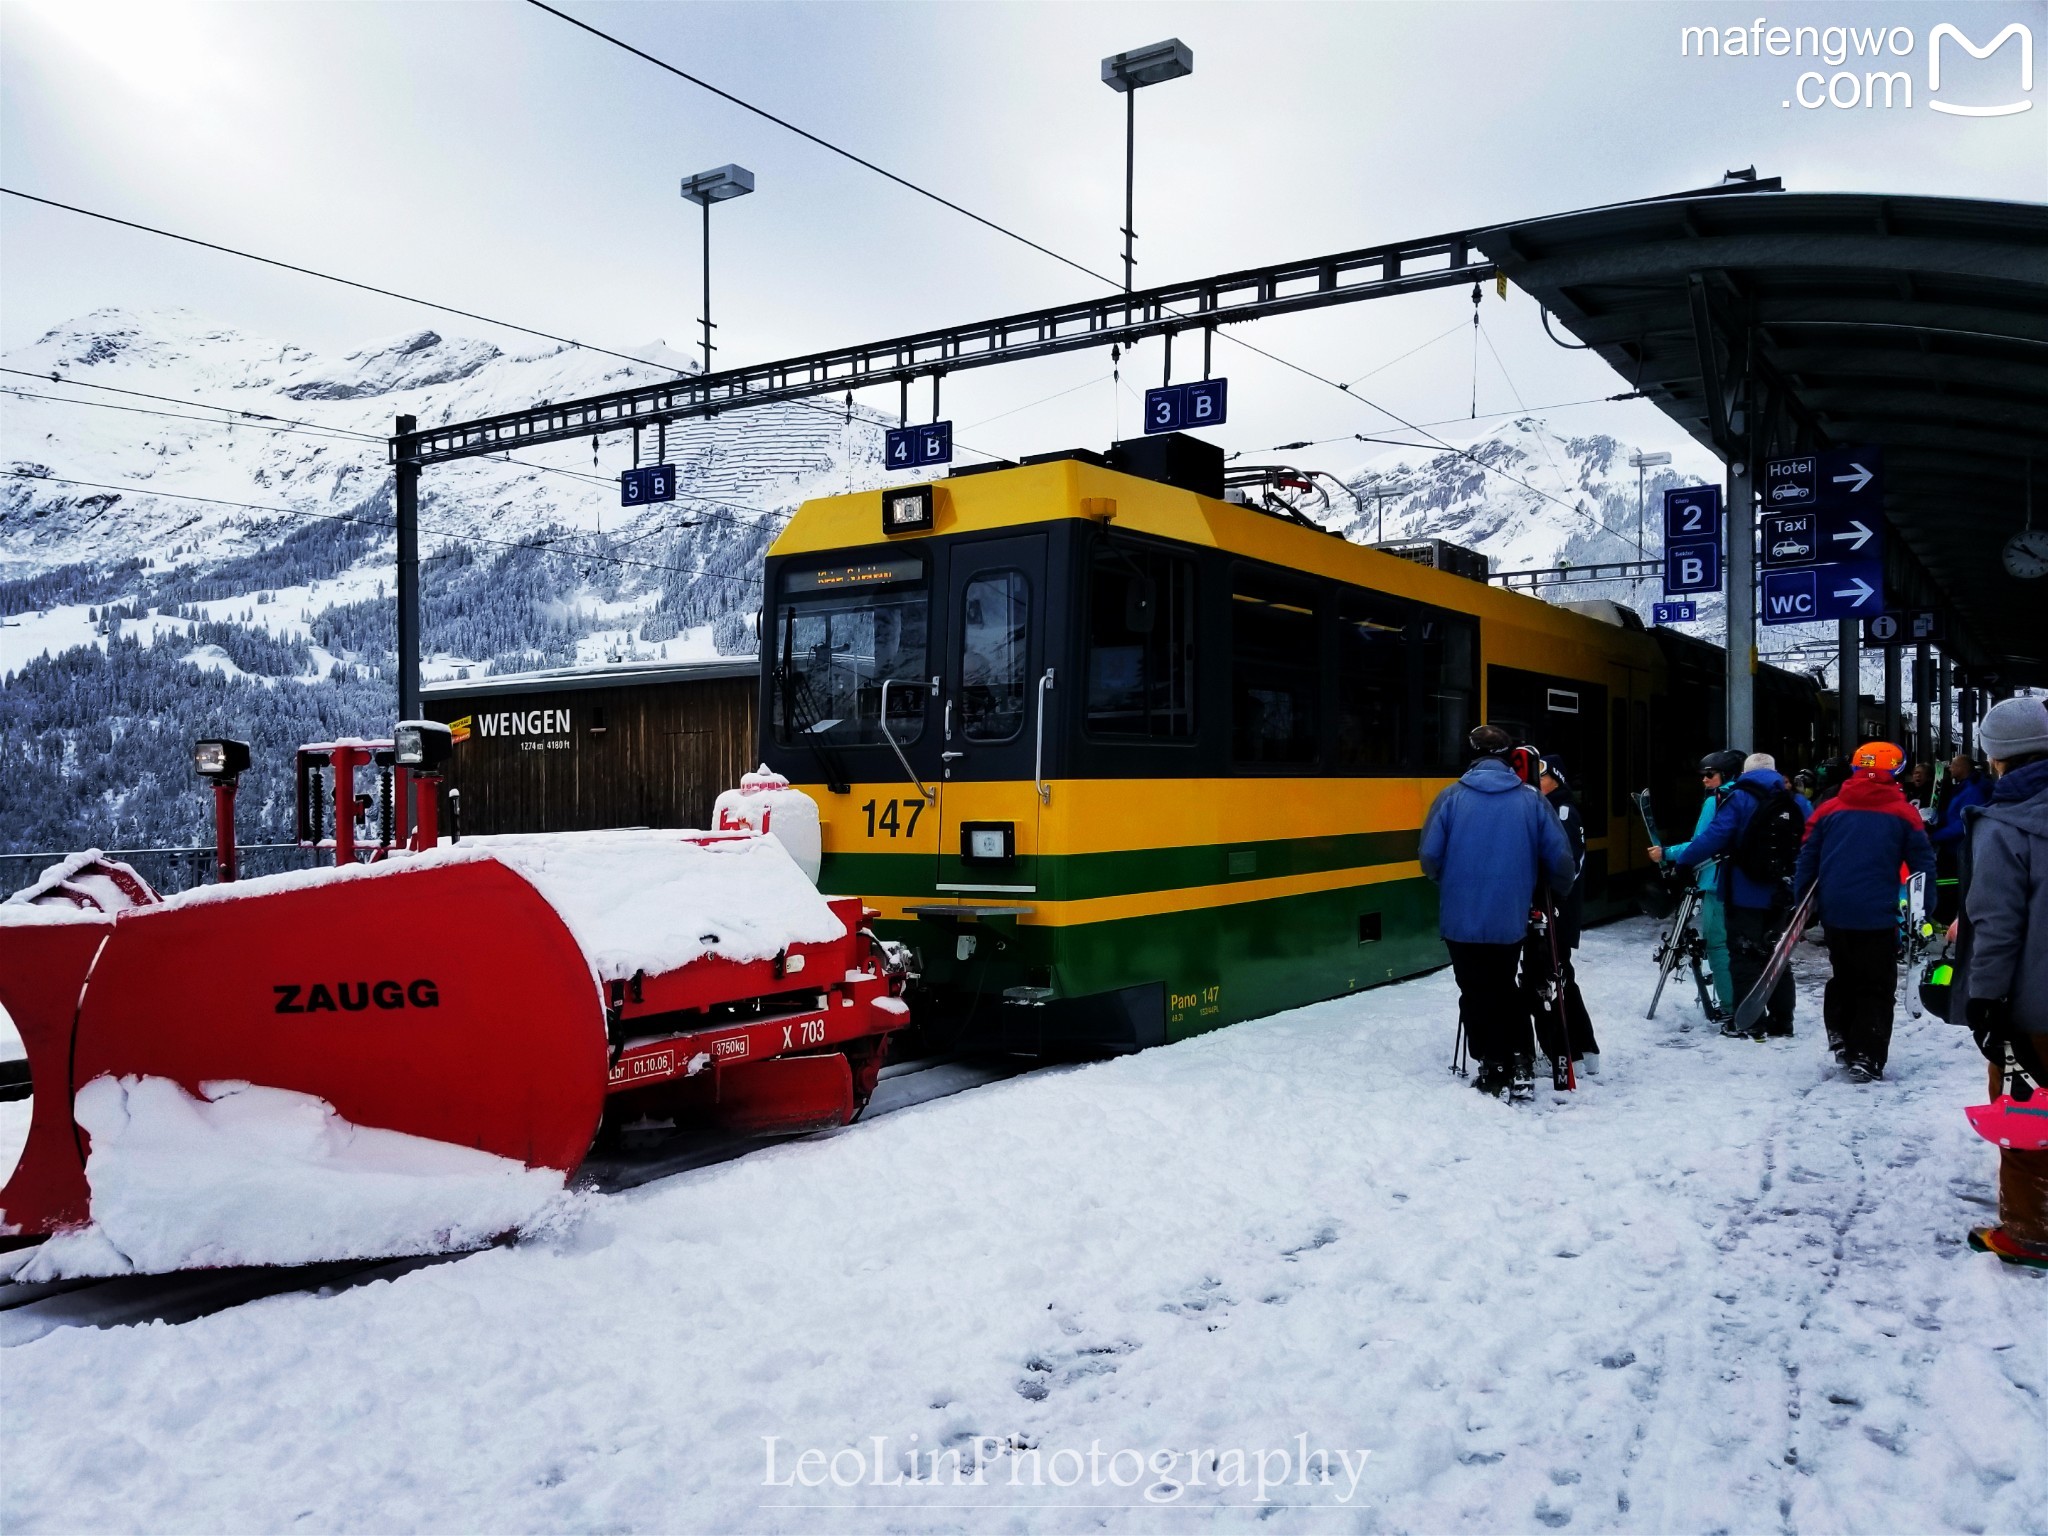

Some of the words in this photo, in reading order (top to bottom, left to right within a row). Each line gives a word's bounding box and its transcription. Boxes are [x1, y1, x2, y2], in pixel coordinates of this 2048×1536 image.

[1156, 402, 1171, 424] 3
[1196, 395, 1212, 418] B
[894, 441, 908, 461] 4
[927, 437, 940, 457] B
[1770, 460, 1812, 477] Hotel
[628, 481, 639, 499] 5
[654, 477, 665, 495] B
[1682, 505, 1702, 531] 2
[1775, 518, 1807, 533] Taxi
[1682, 558, 1704, 584] B
[1659, 609, 1668, 620] 3
[1681, 608, 1690, 618] B
[1770, 594, 1812, 614] WC
[478, 709, 570, 737] WENGEN
[862, 799, 925, 838] 147
[273, 979, 439, 1014] ZAUGG
[1171, 994, 1197, 1011] Pano
[1202, 986, 1219, 1004] 147
[782, 1025, 793, 1049] X
[800, 1019, 825, 1045] 703
[716, 1040, 745, 1056] 3750kg
[634, 1055, 668, 1075] 01.10.06
[1558, 1055, 1569, 1085] RTM
